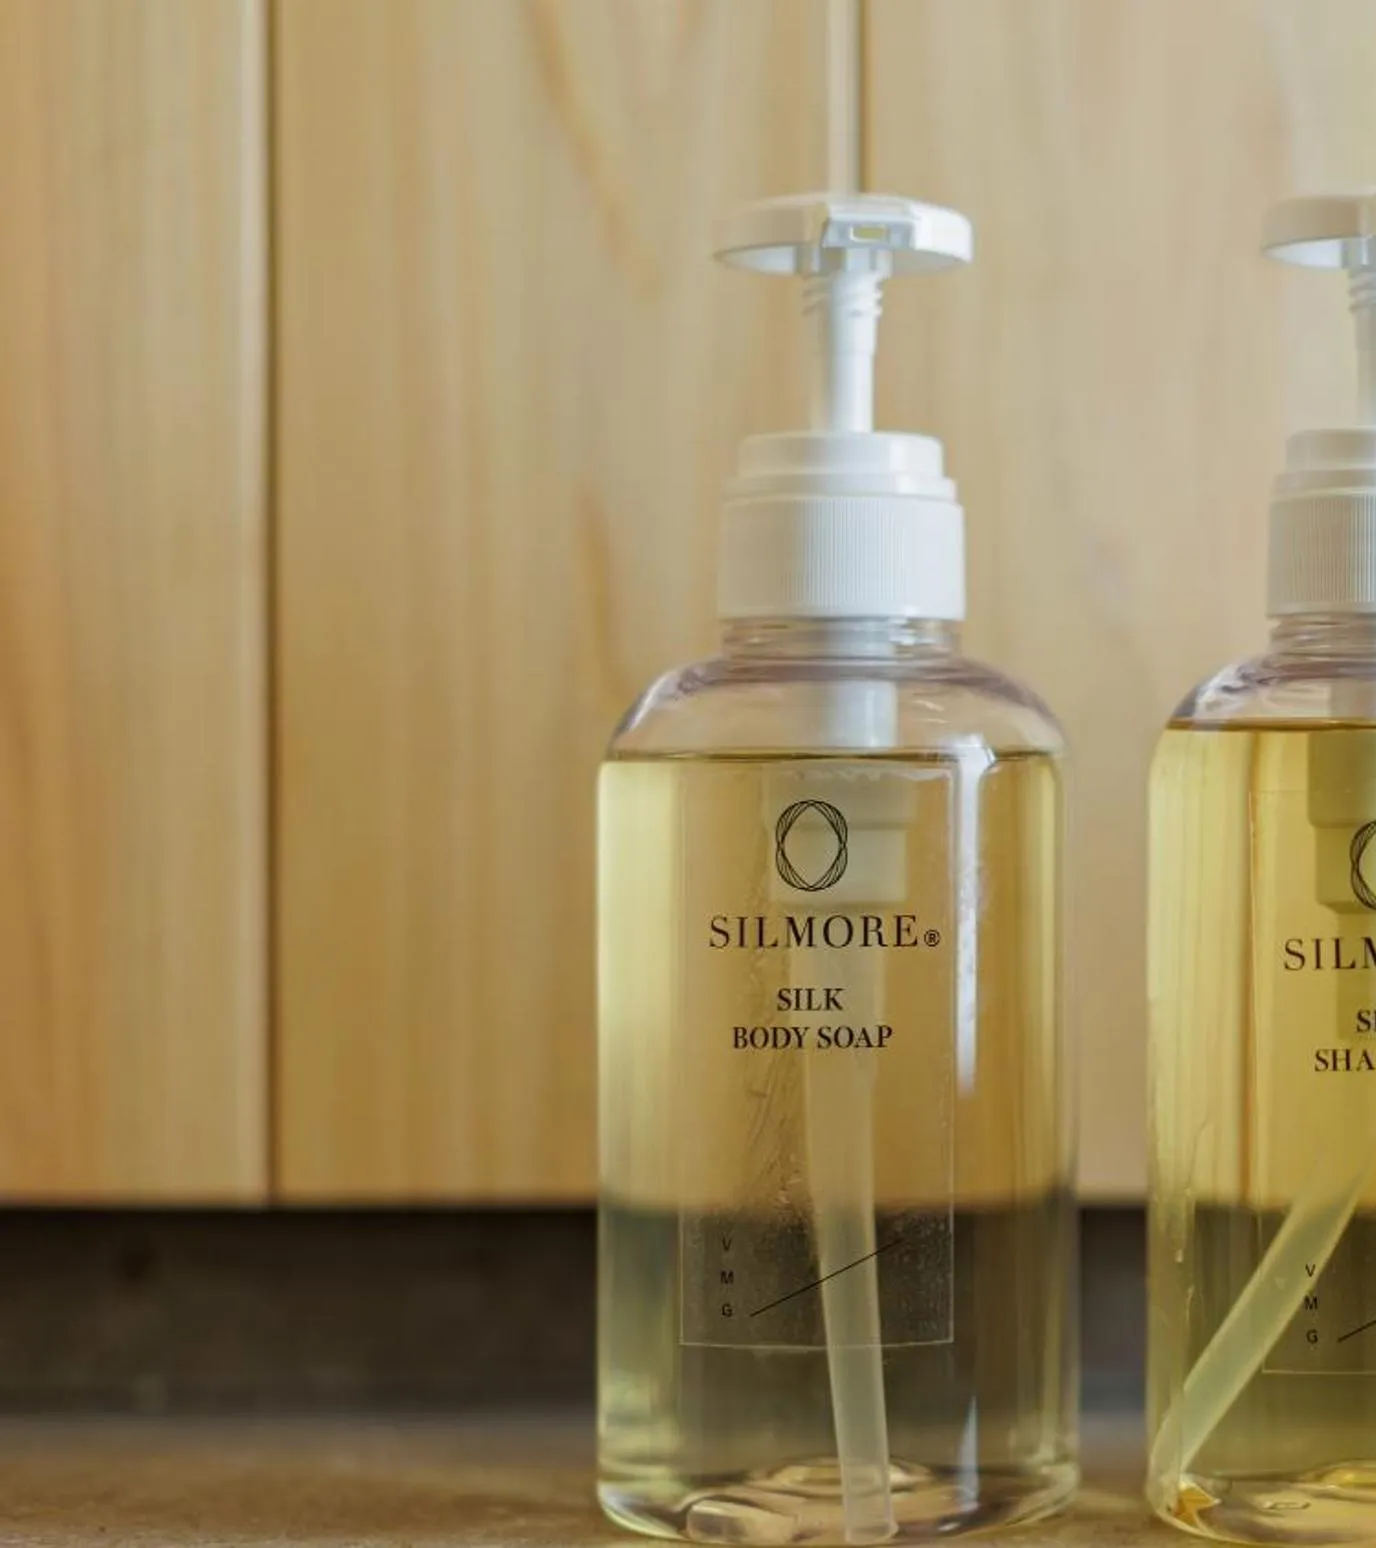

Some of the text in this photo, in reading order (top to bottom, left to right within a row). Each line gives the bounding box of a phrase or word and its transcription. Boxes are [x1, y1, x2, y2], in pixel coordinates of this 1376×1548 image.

[776, 988, 844, 1011] SILK
[732, 1025, 893, 1050] BODY SOAP
[721, 1237, 733, 1251] V
[1305, 1264, 1316, 1277] V
[720, 1271, 734, 1285] M
[1304, 1297, 1318, 1310] M
[721, 1304, 733, 1318] G
[1306, 1330, 1318, 1344] G
